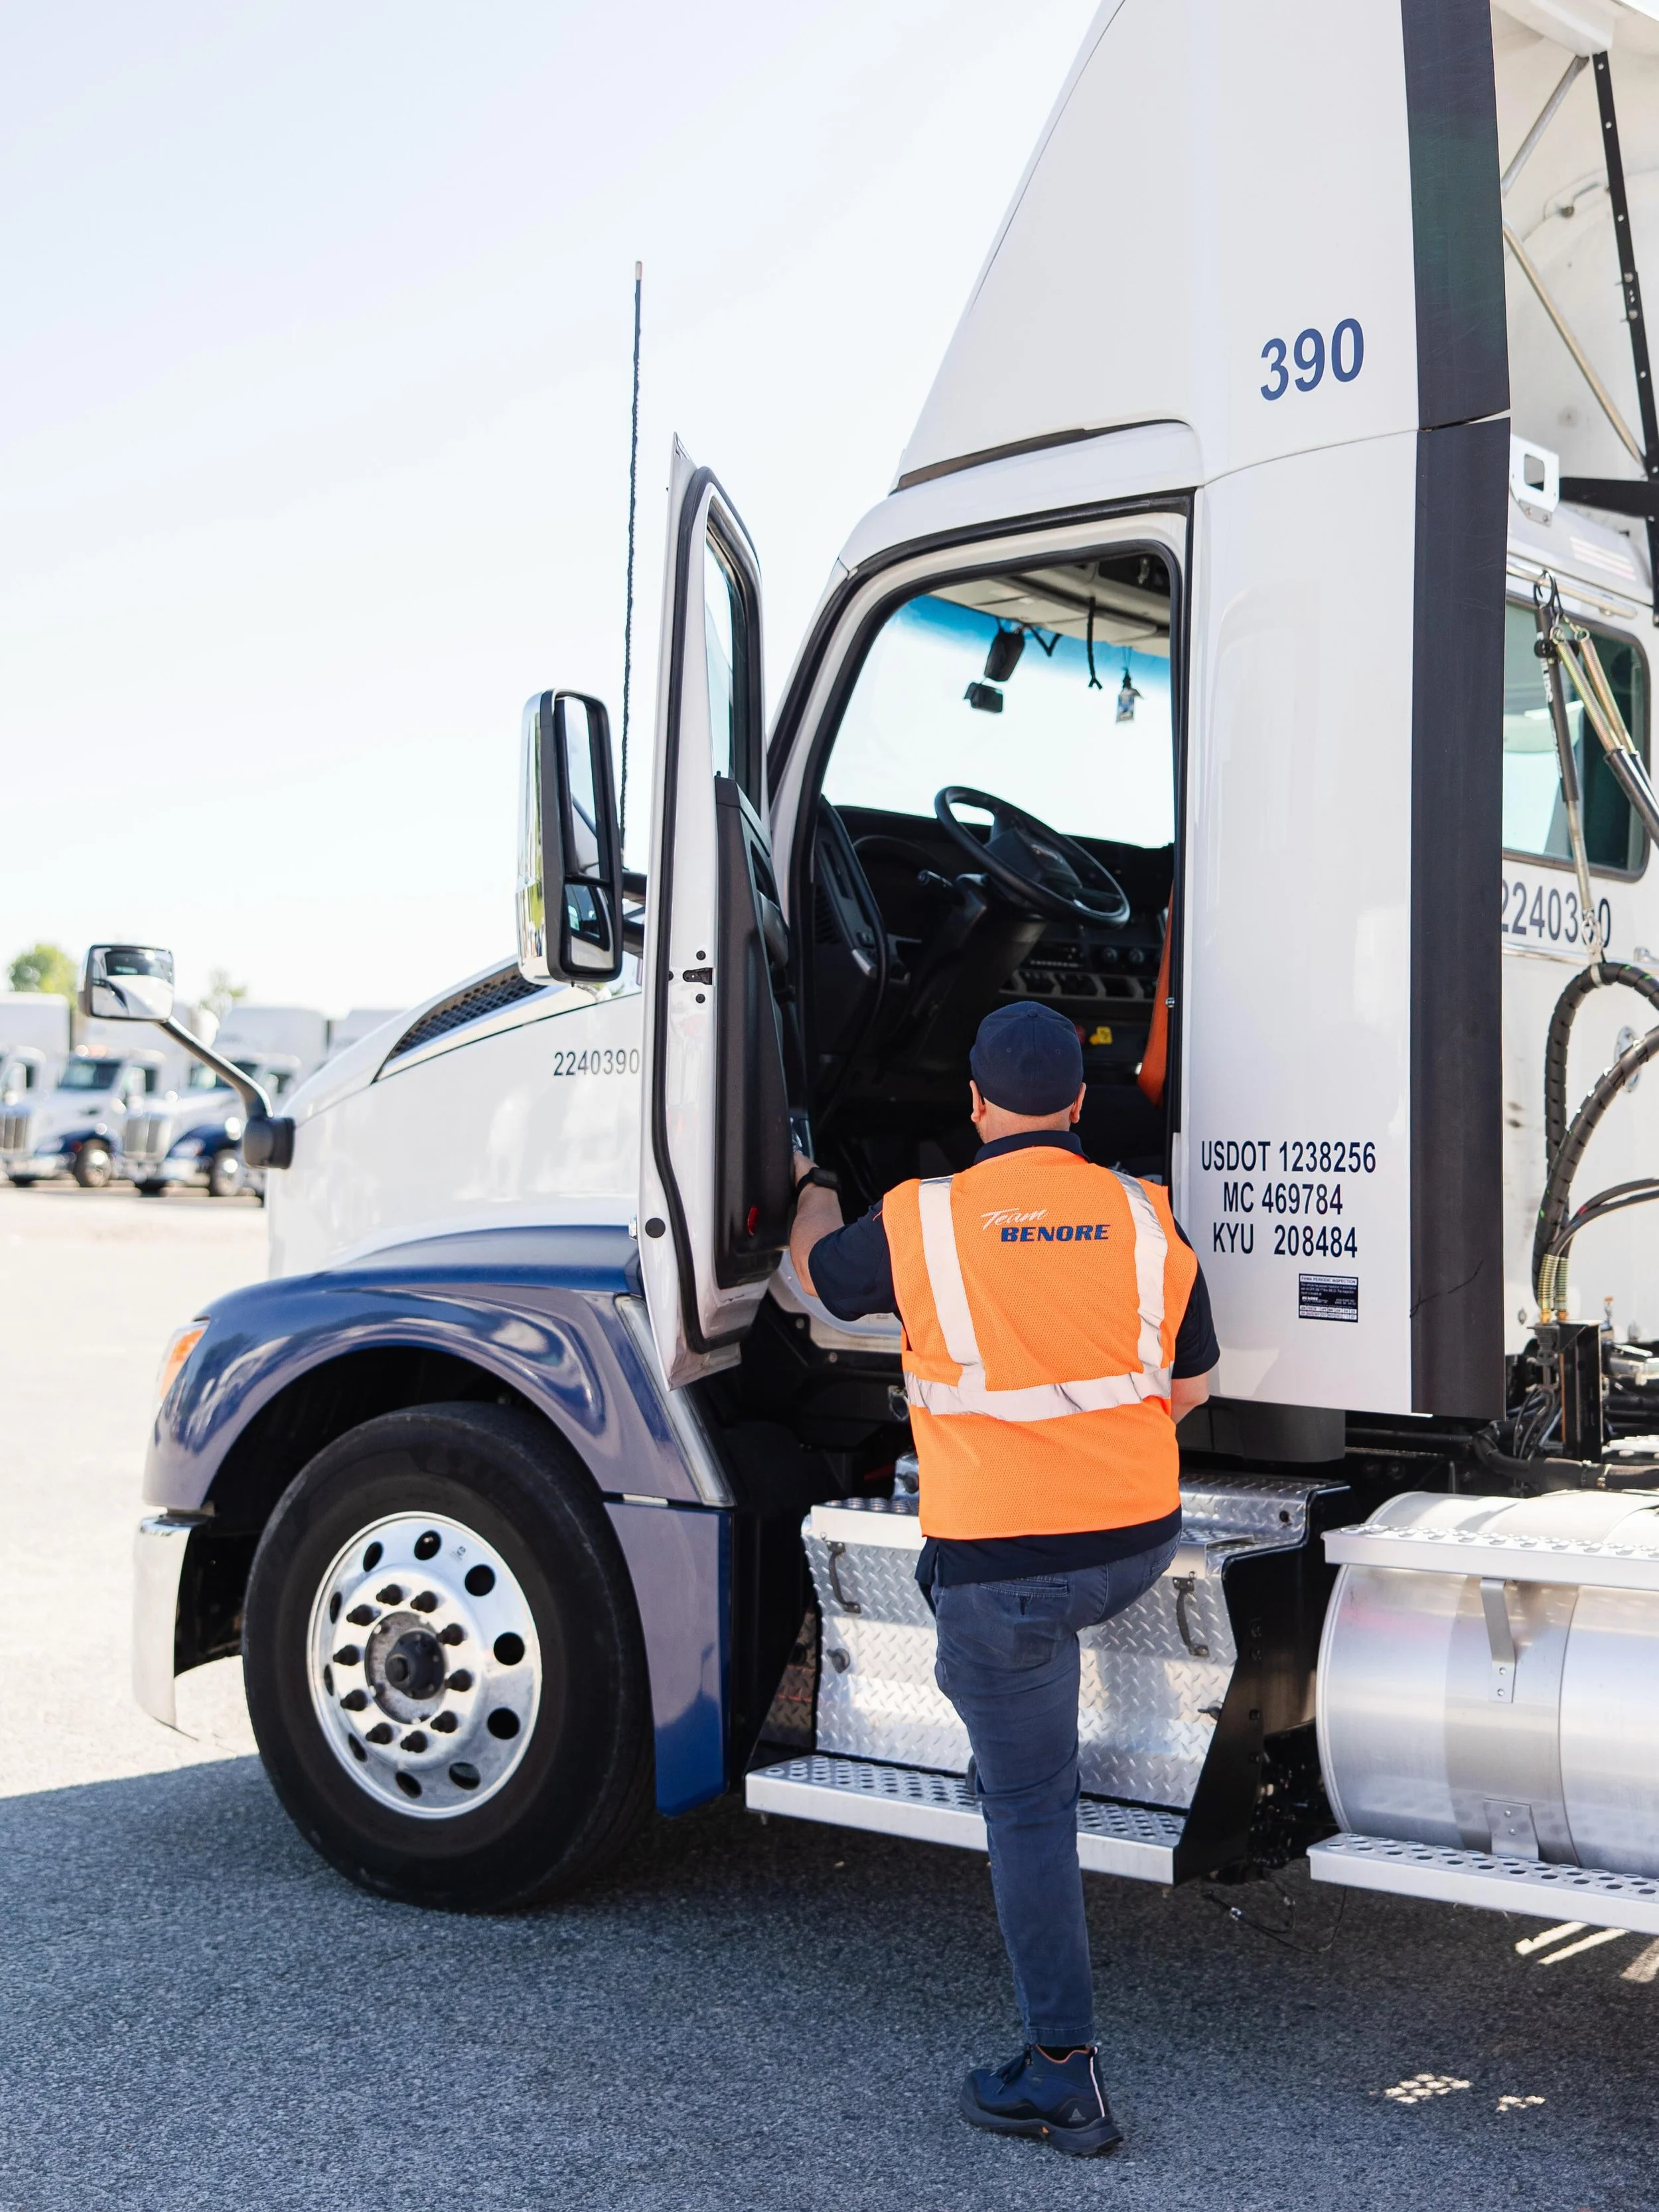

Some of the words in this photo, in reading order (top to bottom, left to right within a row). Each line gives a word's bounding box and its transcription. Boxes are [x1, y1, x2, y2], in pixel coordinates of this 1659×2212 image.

[1260, 318, 1364, 401] 390
[553, 1048, 640, 1076] 2240390
[1202, 1140, 1271, 1171] USDOT
[1279, 1142, 1376, 1173] 1238256
[1224, 1182, 1254, 1213] MC
[1262, 1183, 1342, 1215] 469784
[979, 1207, 1047, 1232] Team
[1001, 1224, 1110, 1242] BENORE
[1213, 1222, 1254, 1254] KYU
[1273, 1224, 1357, 1258] 208484
